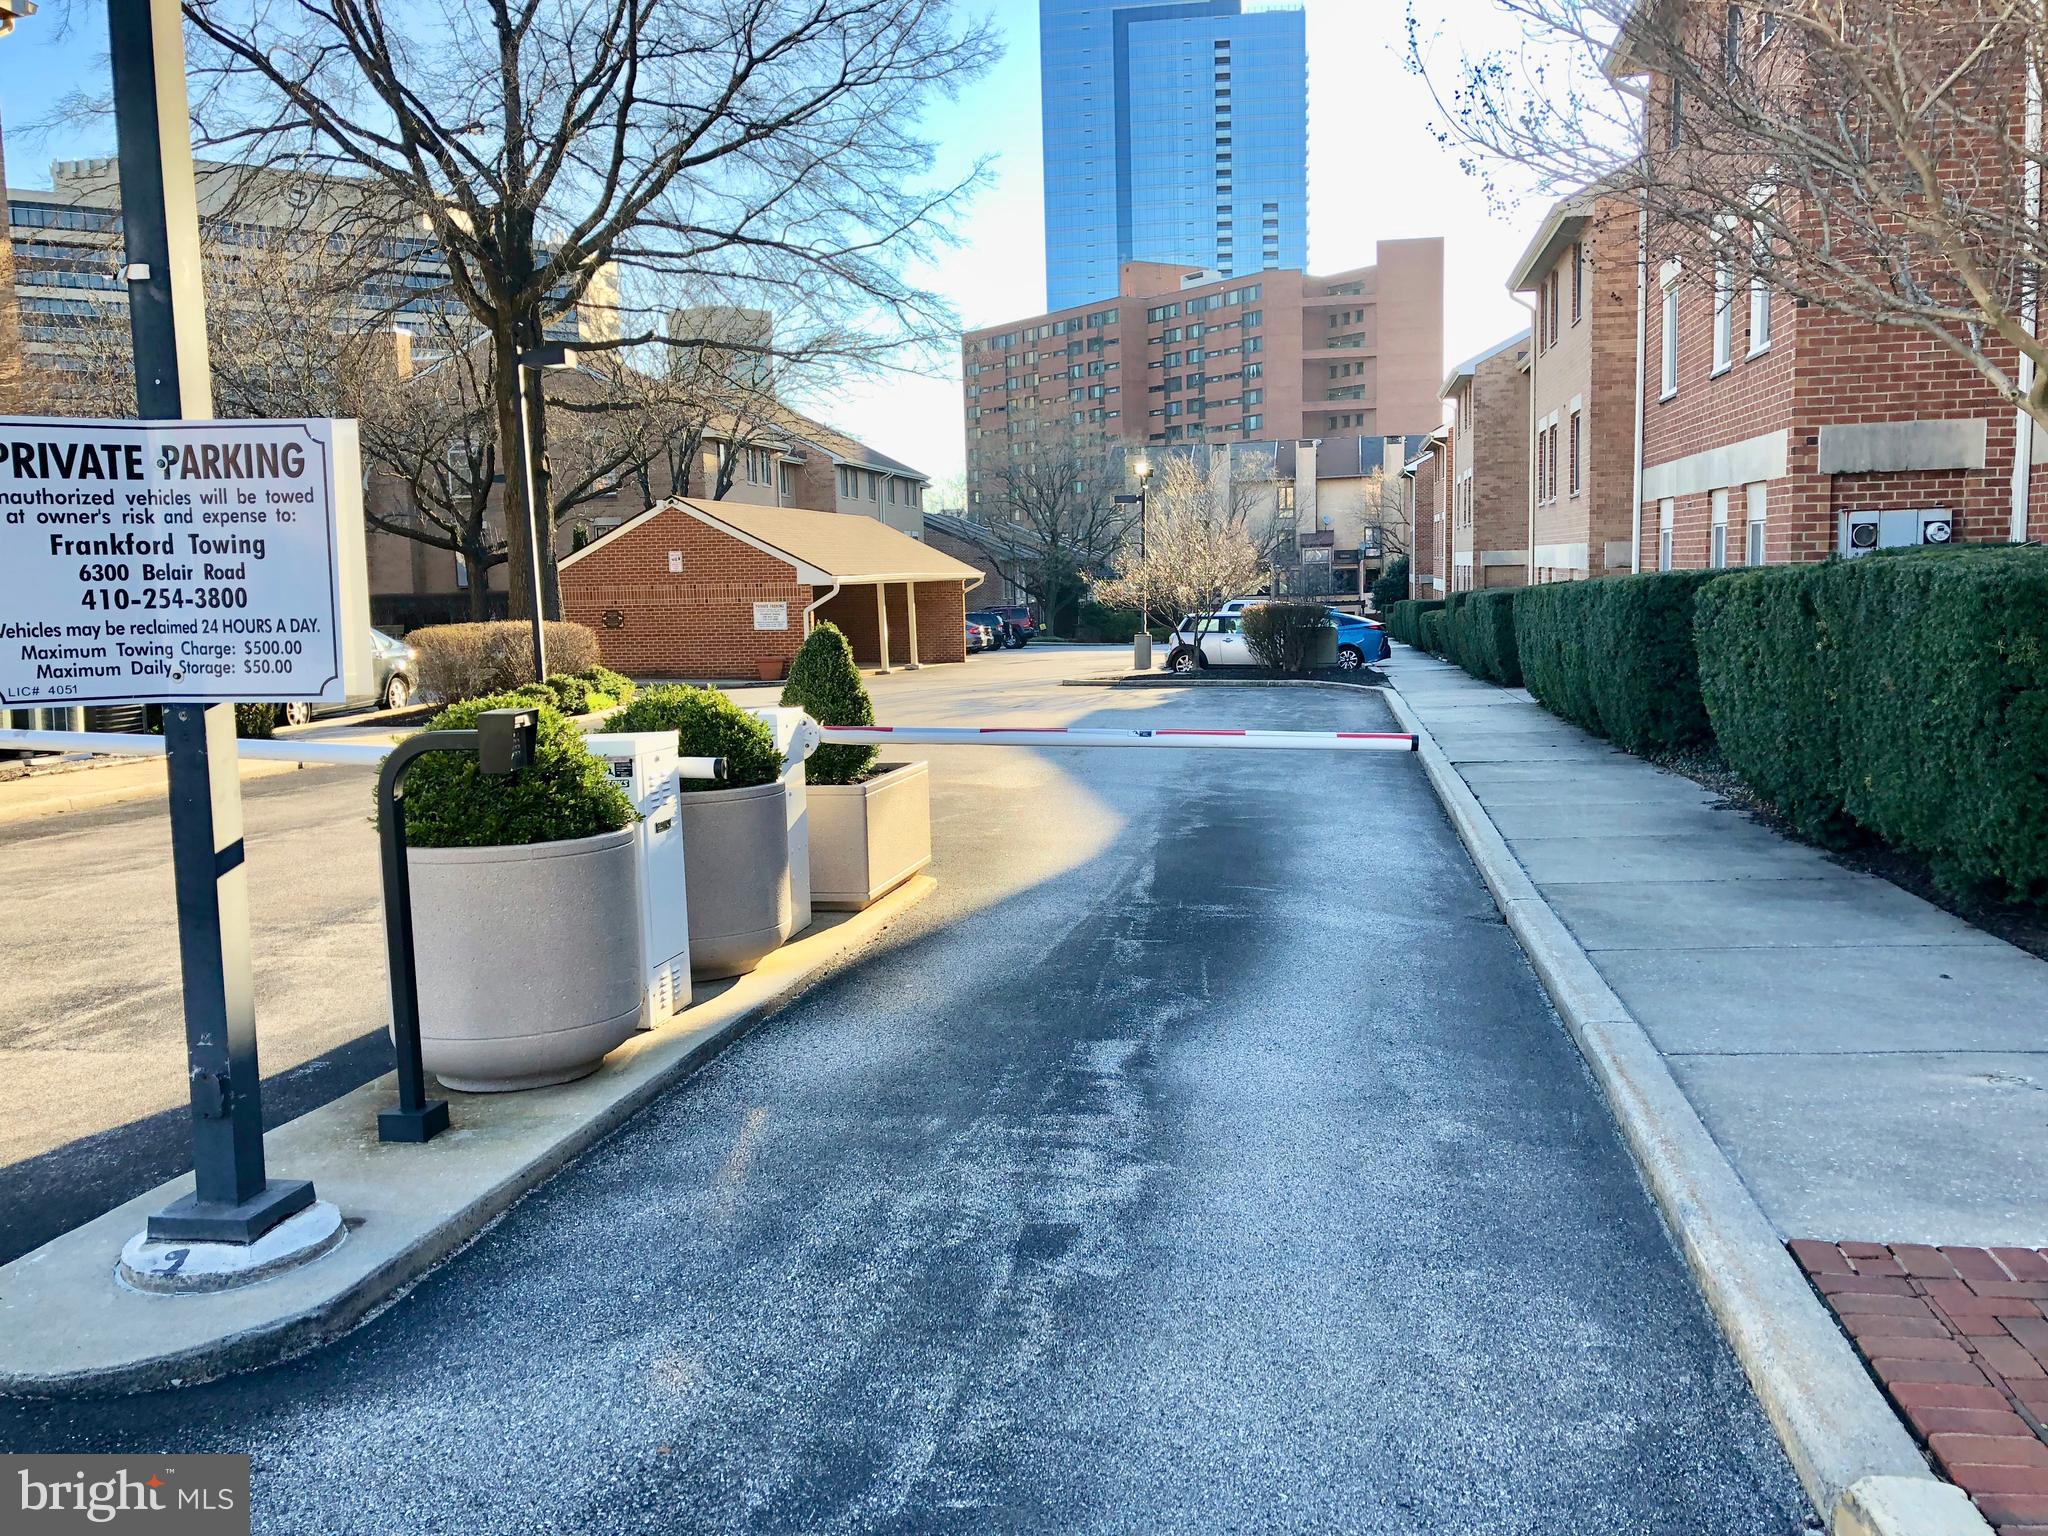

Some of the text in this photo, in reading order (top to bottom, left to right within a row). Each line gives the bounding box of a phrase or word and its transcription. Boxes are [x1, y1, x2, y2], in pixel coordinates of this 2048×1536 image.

[162, 443, 305, 480] PARKING
[0, 487, 314, 505] nauthorized vehicles will be towed
[7, 507, 295, 527] at owner's risk and expense to:
[50, 533, 265, 559] Frankford Towing
[79, 562, 245, 581] 6300 Belair Road
[82, 588, 247, 610] 410-254-3800
[67, 626, 101, 640] may
[105, 620, 125, 635] be
[130, 619, 197, 634] reclaimed
[202, 619, 218, 633] 24
[223, 619, 272, 633] HOURS
[276, 619, 286, 632] A
[290, 618, 320, 632] DAY.
[22, 640, 302, 660] Maximum Towing Charge: $500.00
[37, 659, 292, 679] Maximum Daily Storage: $50.00
[8, 685, 77, 697] LIC# 4051
